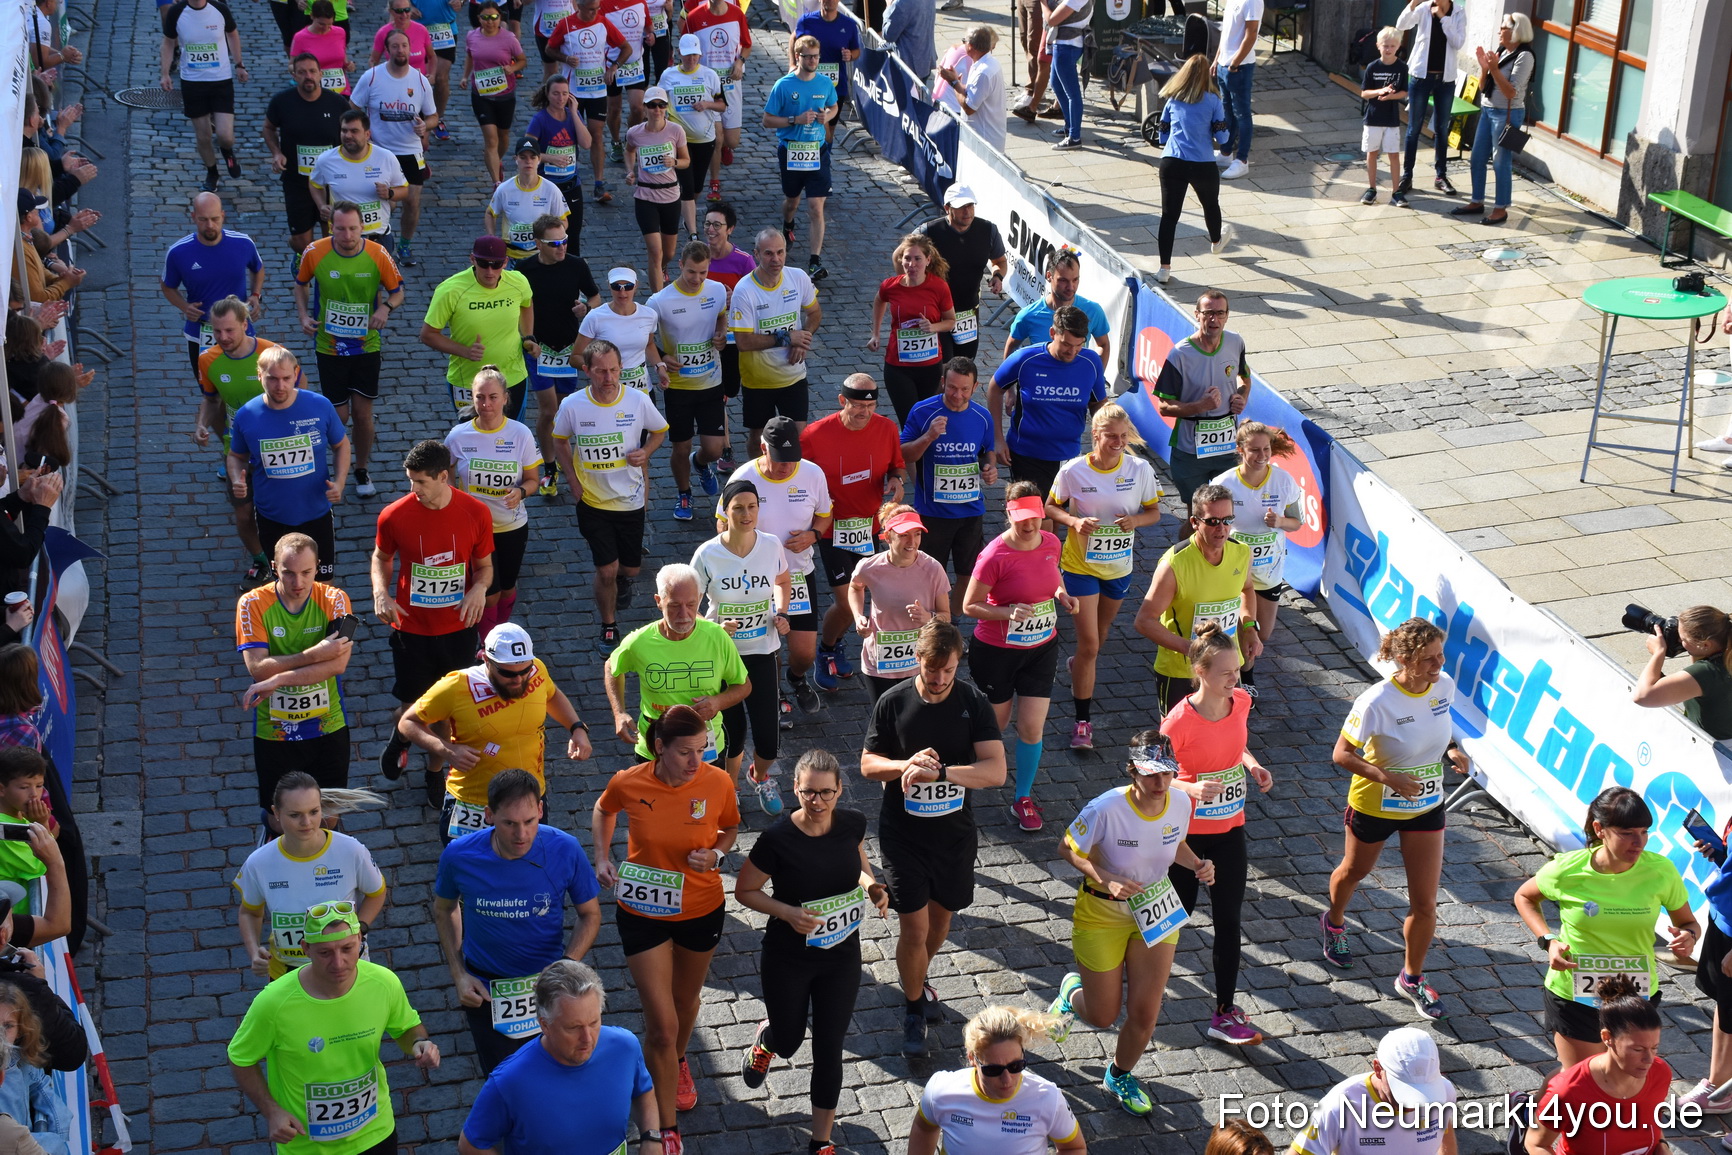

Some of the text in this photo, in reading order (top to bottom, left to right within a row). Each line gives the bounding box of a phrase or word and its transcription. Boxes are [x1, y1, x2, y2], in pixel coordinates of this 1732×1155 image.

[430, 31, 451, 41] 2479
[190, 52, 215, 62] 2491
[476, 67, 503, 79] BOCK
[576, 67, 603, 77] BOCK
[618, 68, 639, 78] 2457
[323, 78, 342, 87] 273
[479, 76, 503, 88] 1266
[579, 76, 602, 86] 2455
[675, 85, 704, 94] BOCK
[677, 94, 702, 105] 2657
[548, 147, 575, 155] BOCK
[641, 143, 671, 155] BOCK
[791, 152, 815, 161] 2022
[511, 224, 534, 232] BOC
[513, 231, 534, 242] 260
[1005, 251, 1037, 287] stawerke
[329, 302, 367, 314] BOCK
[469, 300, 504, 310] CRAFT
[330, 313, 364, 327] 2507
[732, 310, 742, 320] 20
[761, 312, 797, 329] BOCK
[330, 327, 361, 335] ANDREAS
[952, 318, 975, 333] 2427
[679, 340, 713, 353] BOCK
[902, 338, 935, 351] 2571
[683, 352, 711, 365] 2423
[908, 351, 930, 359] SARAH
[689, 365, 708, 374] JONAS
[1035, 385, 1080, 396] SYSCAD
[1198, 417, 1234, 430] BOCK
[578, 433, 620, 445] BOCK
[1201, 429, 1234, 445] 2017
[262, 437, 308, 451] BOCK
[935, 442, 976, 452] SYSCAD
[1203, 445, 1232, 453] WERNER
[267, 450, 308, 466] 2177
[584, 447, 620, 460] 1191
[271, 465, 309, 475] CHRISTOF
[473, 460, 518, 472] BOCK
[938, 464, 975, 476] BOCK
[474, 472, 512, 487] 1190
[939, 477, 975, 491] 2143
[942, 492, 972, 500] THOMAS
[1299, 476, 1320, 532] is
[837, 518, 871, 528] BOCK
[839, 530, 869, 544] 3004
[1094, 537, 1131, 550] 2198
[415, 565, 463, 578] BOCK
[417, 579, 460, 593] 2175
[721, 569, 770, 594] SUSPA
[420, 595, 455, 603] THOMAS
[722, 601, 769, 615] BOCK
[1199, 600, 1240, 614] BOCK
[1015, 617, 1052, 632] 2444
[1021, 633, 1044, 642] KARIN
[884, 658, 918, 669] STEFAN
[645, 661, 714, 690] OPF
[277, 693, 321, 710] 1281
[287, 712, 311, 720] RALF
[1348, 714, 1360, 728] 20
[911, 783, 959, 800] 2185
[919, 801, 951, 812] ANDRÉ
[1205, 802, 1240, 816] CAROLIN
[1074, 817, 1087, 835] 20
[1162, 824, 1172, 834] 20
[314, 866, 327, 875] 20
[622, 867, 678, 886] BOCK
[269, 880, 289, 889] BOCK
[622, 882, 672, 905] 2611
[1132, 878, 1171, 907] BOCK
[476, 897, 528, 908] Kirwaläufer
[625, 901, 671, 914] BARBARA
[809, 891, 858, 913] BOCK
[1140, 896, 1175, 927] 2011
[815, 907, 860, 935] 2610
[1160, 919, 1173, 932] RIA
[821, 926, 852, 945] NADINE
[1578, 956, 1643, 971] BOCK
[496, 977, 536, 995] BOC
[501, 1000, 536, 1019] 255
[507, 1020, 540, 1034] JOHAN
[313, 1075, 374, 1098] BOCK
[316, 1090, 371, 1121] 2237
[951, 1114, 974, 1124] BOCK
[1002, 1112, 1016, 1120] 20
[319, 1111, 370, 1135] ANDREAS
